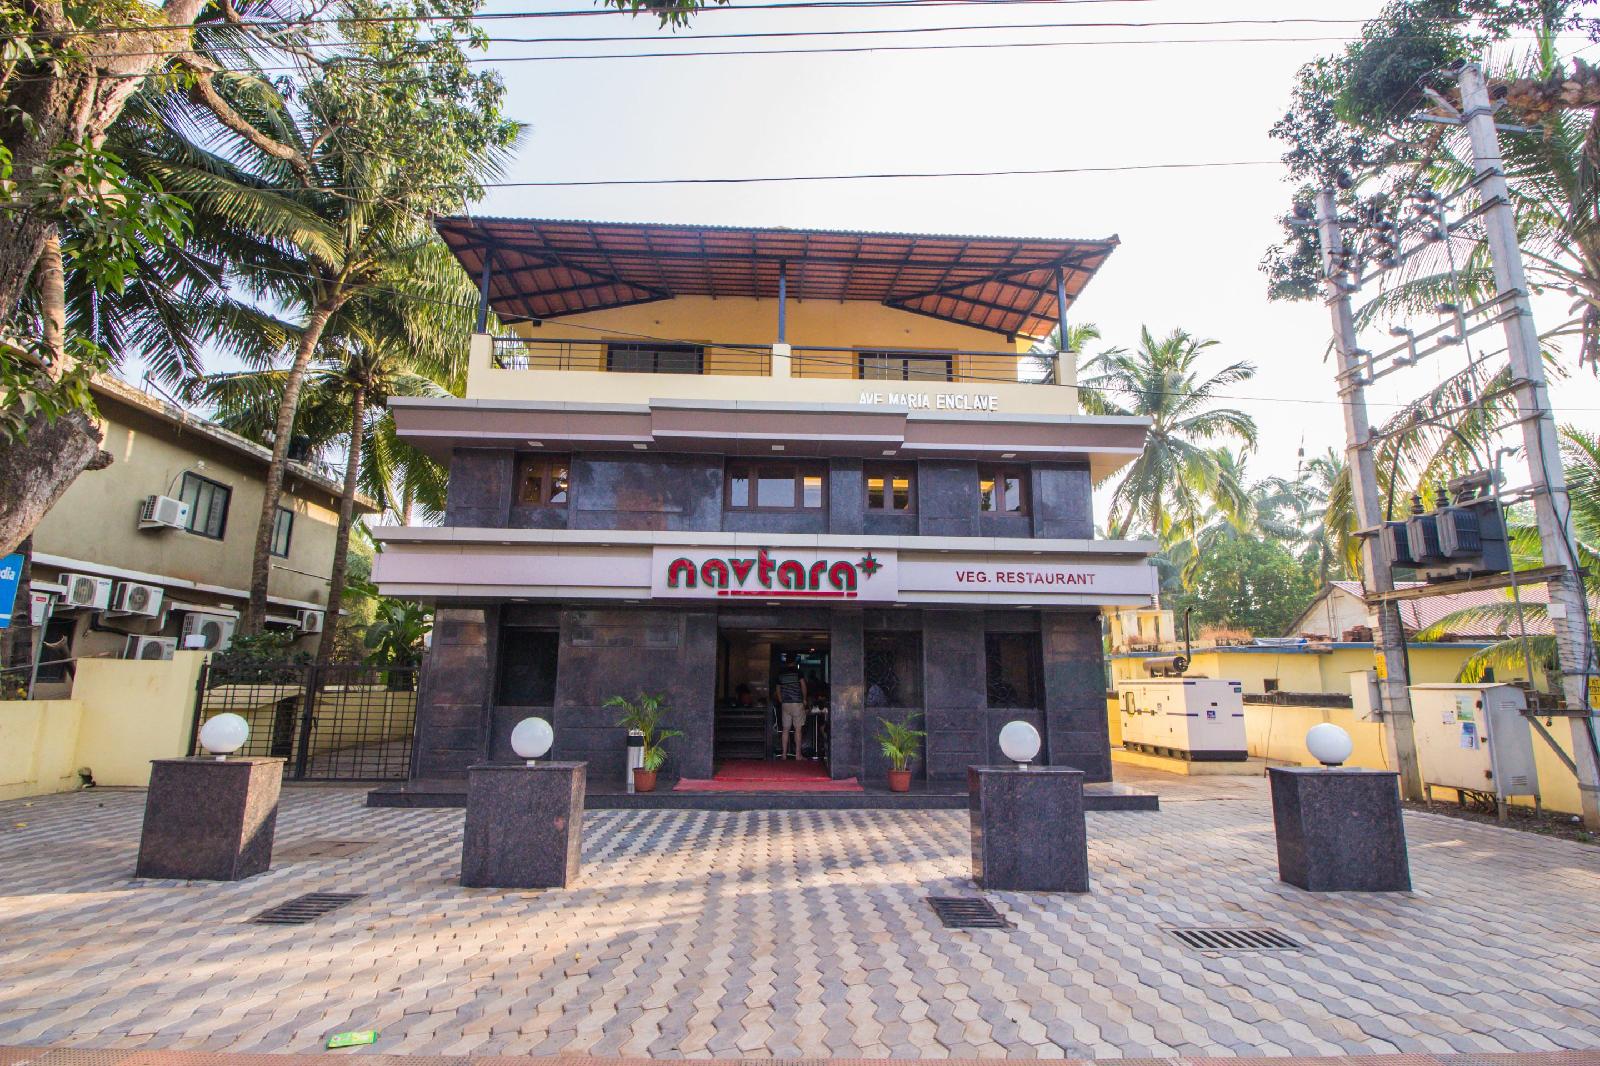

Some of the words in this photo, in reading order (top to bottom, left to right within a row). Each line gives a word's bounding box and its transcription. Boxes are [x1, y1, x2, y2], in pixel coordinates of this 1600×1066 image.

[859, 392, 883, 405] AVE
[889, 392, 930, 409] MARIA
[936, 394, 998, 410] ENCLAVE
[667, 548, 858, 591] navtara
[956, 571, 991, 583] VEG.
[996, 572, 1095, 585] RESTAURANT
